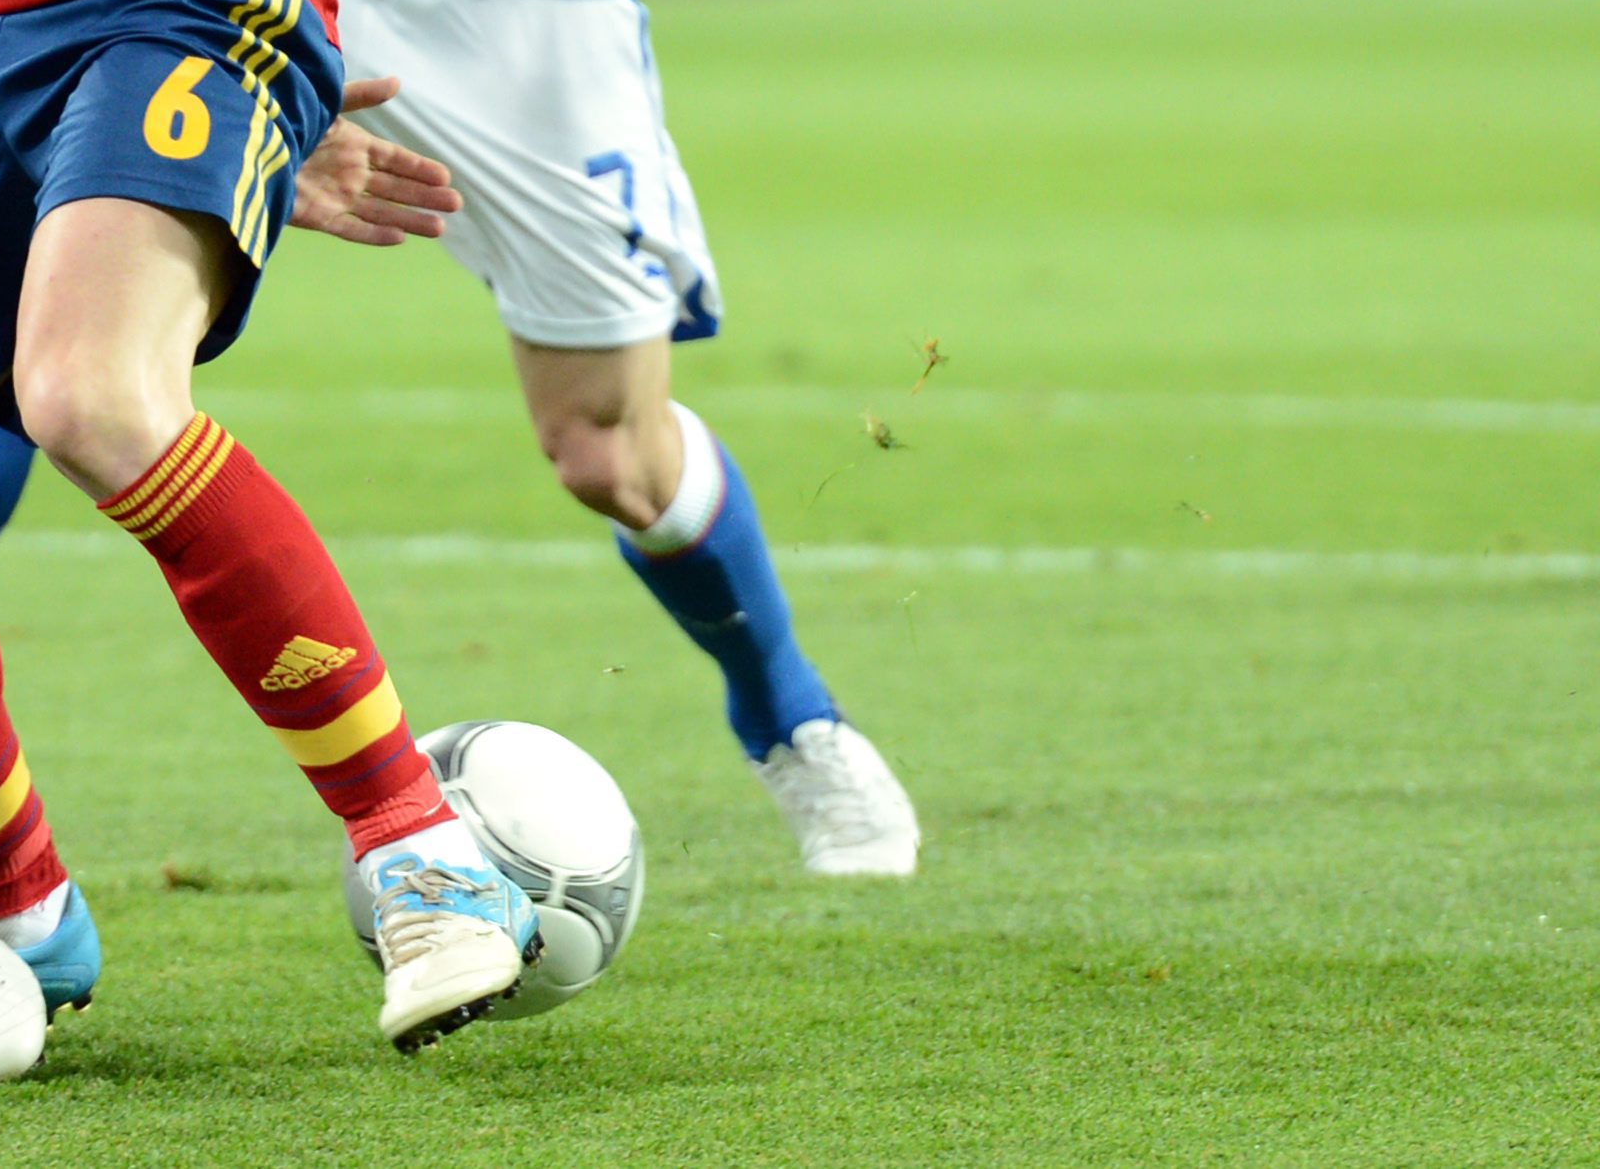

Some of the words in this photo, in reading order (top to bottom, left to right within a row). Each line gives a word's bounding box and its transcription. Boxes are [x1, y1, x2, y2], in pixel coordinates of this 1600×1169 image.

[143, 55, 215, 160] 6
[585, 150, 643, 259] 7
[260, 646, 357, 691] adidas
